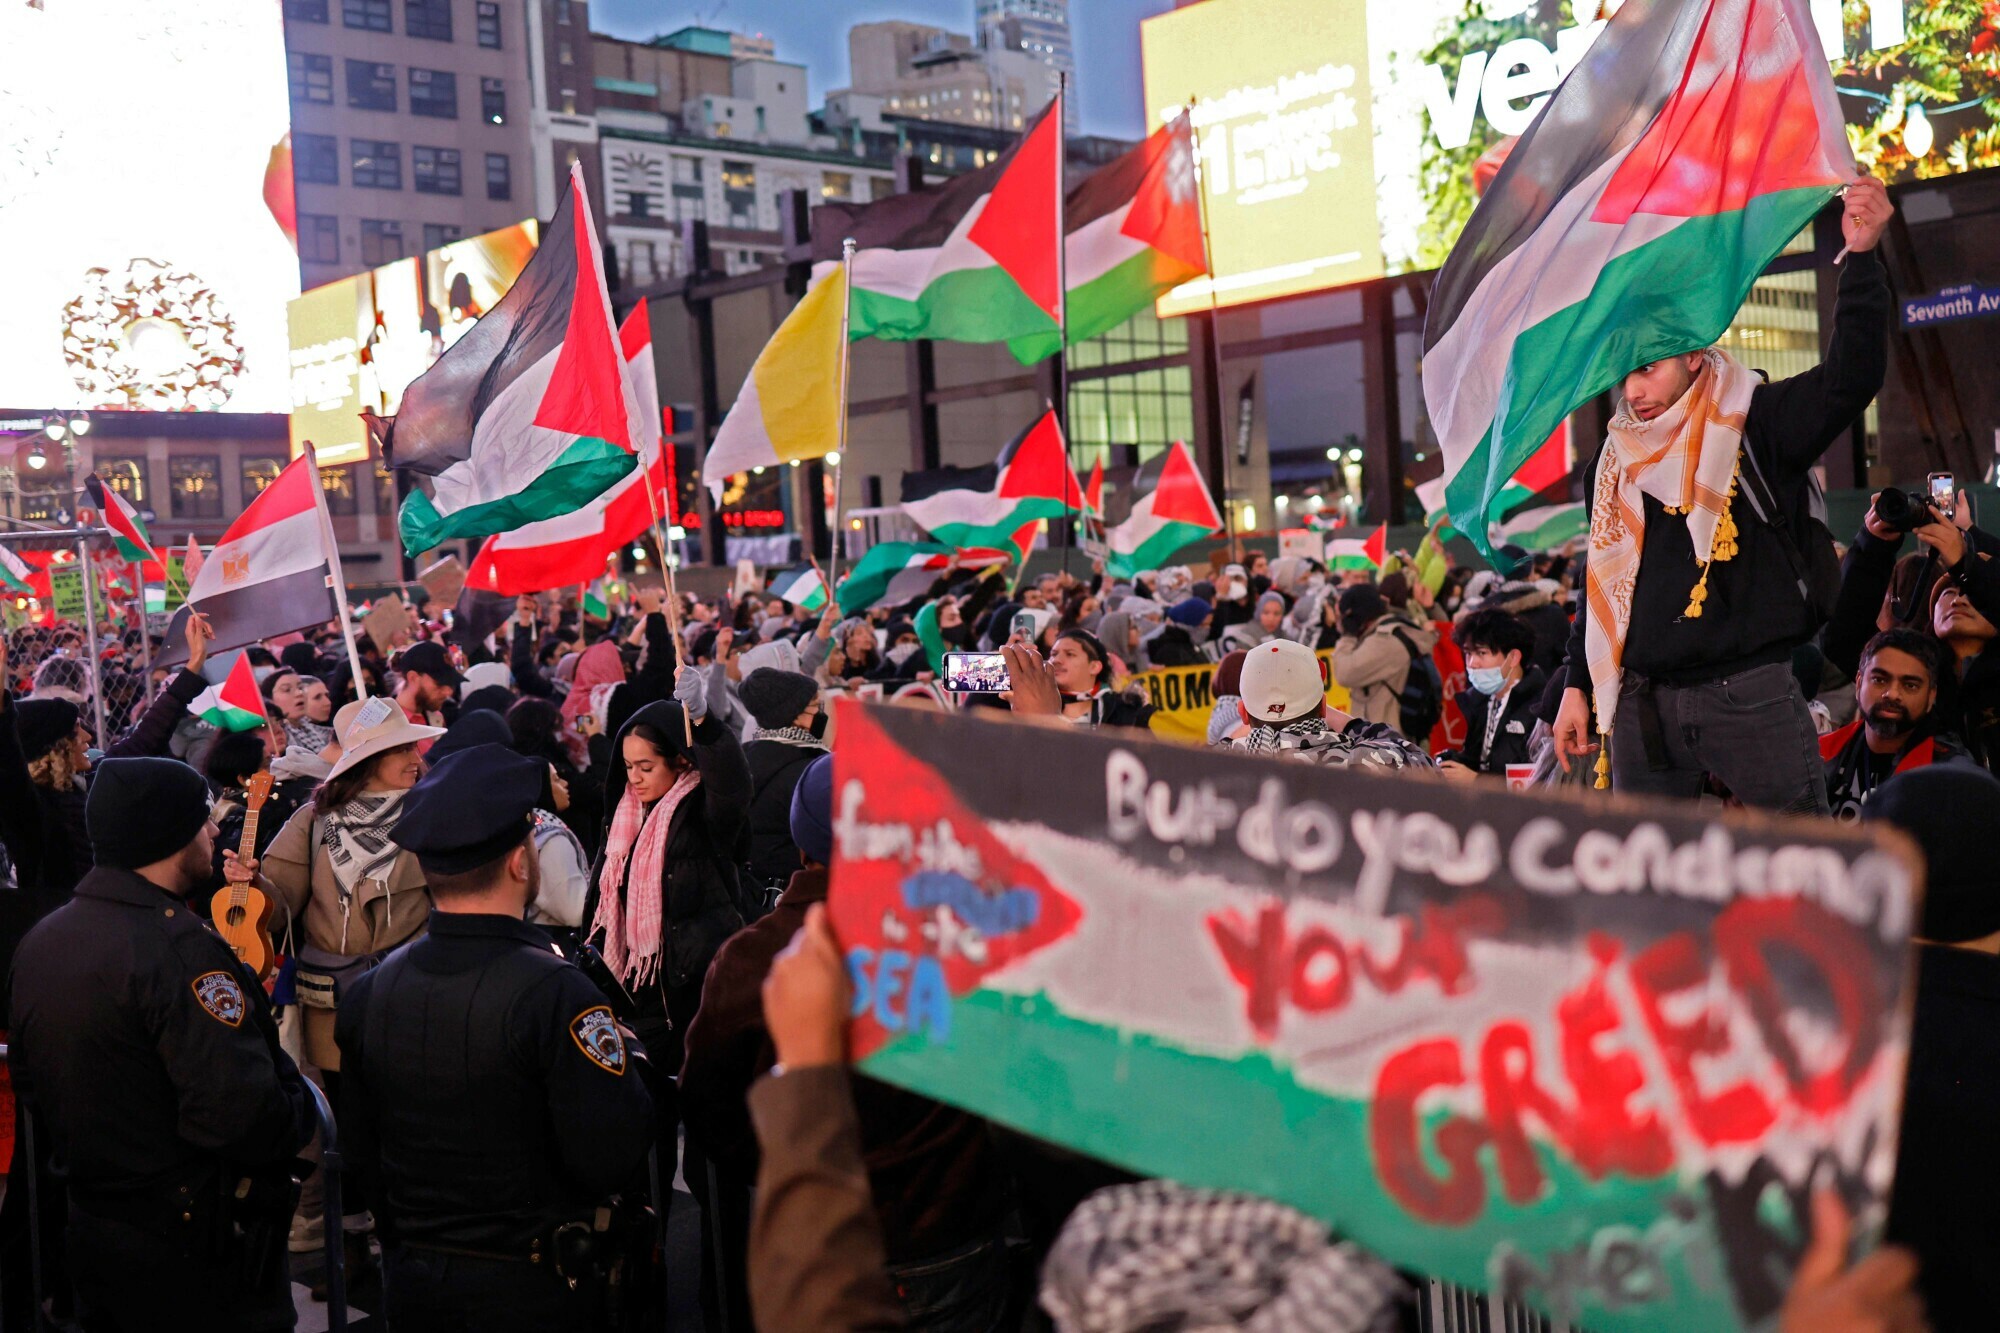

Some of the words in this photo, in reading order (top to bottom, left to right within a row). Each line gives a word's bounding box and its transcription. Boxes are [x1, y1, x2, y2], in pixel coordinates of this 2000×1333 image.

[1906, 295, 1974, 323] Seventh
[1105, 748, 1239, 847] But
[1236, 775, 1345, 874] do
[1350, 808, 1500, 922] you
[202, 974, 226, 985] POLICE
[846, 945, 952, 1044] SEA
[586, 1045, 602, 1059] CITY
[1368, 894, 1890, 1228] GREED
